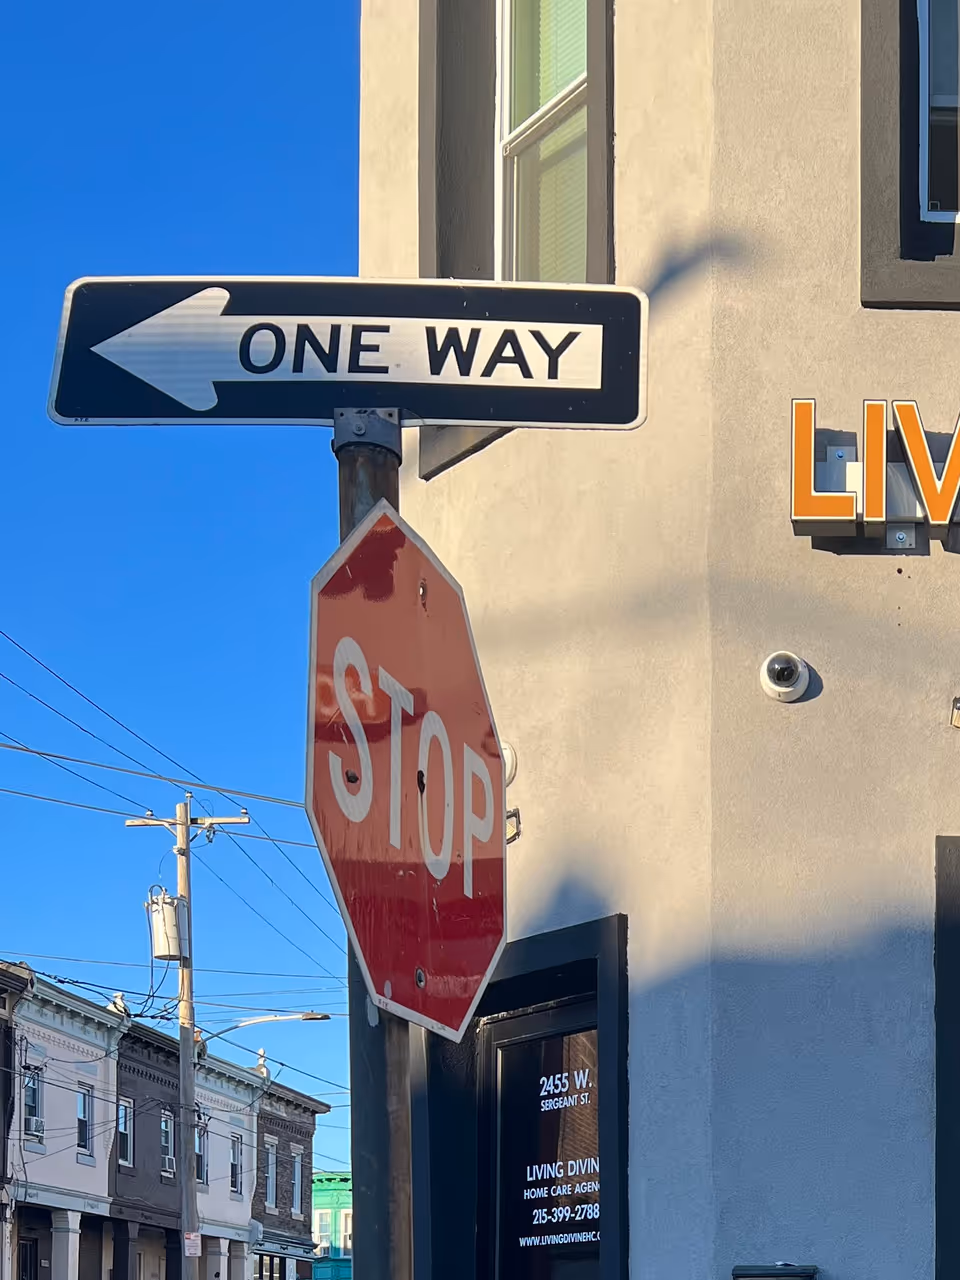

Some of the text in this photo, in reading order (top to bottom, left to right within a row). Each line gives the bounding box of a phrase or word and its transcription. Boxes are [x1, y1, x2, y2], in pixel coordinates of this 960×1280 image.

[238, 322, 583, 380] ONE WAY
[328, 634, 497, 901] STOP
[539, 1068, 593, 1097] 2455 W.
[540, 1092, 591, 1112] SERGEANT ST.
[526, 1161, 564, 1182] LIVING
[523, 1180, 600, 1200] HOME CARE AGEN
[532, 1203, 600, 1225] 215-399-2788
